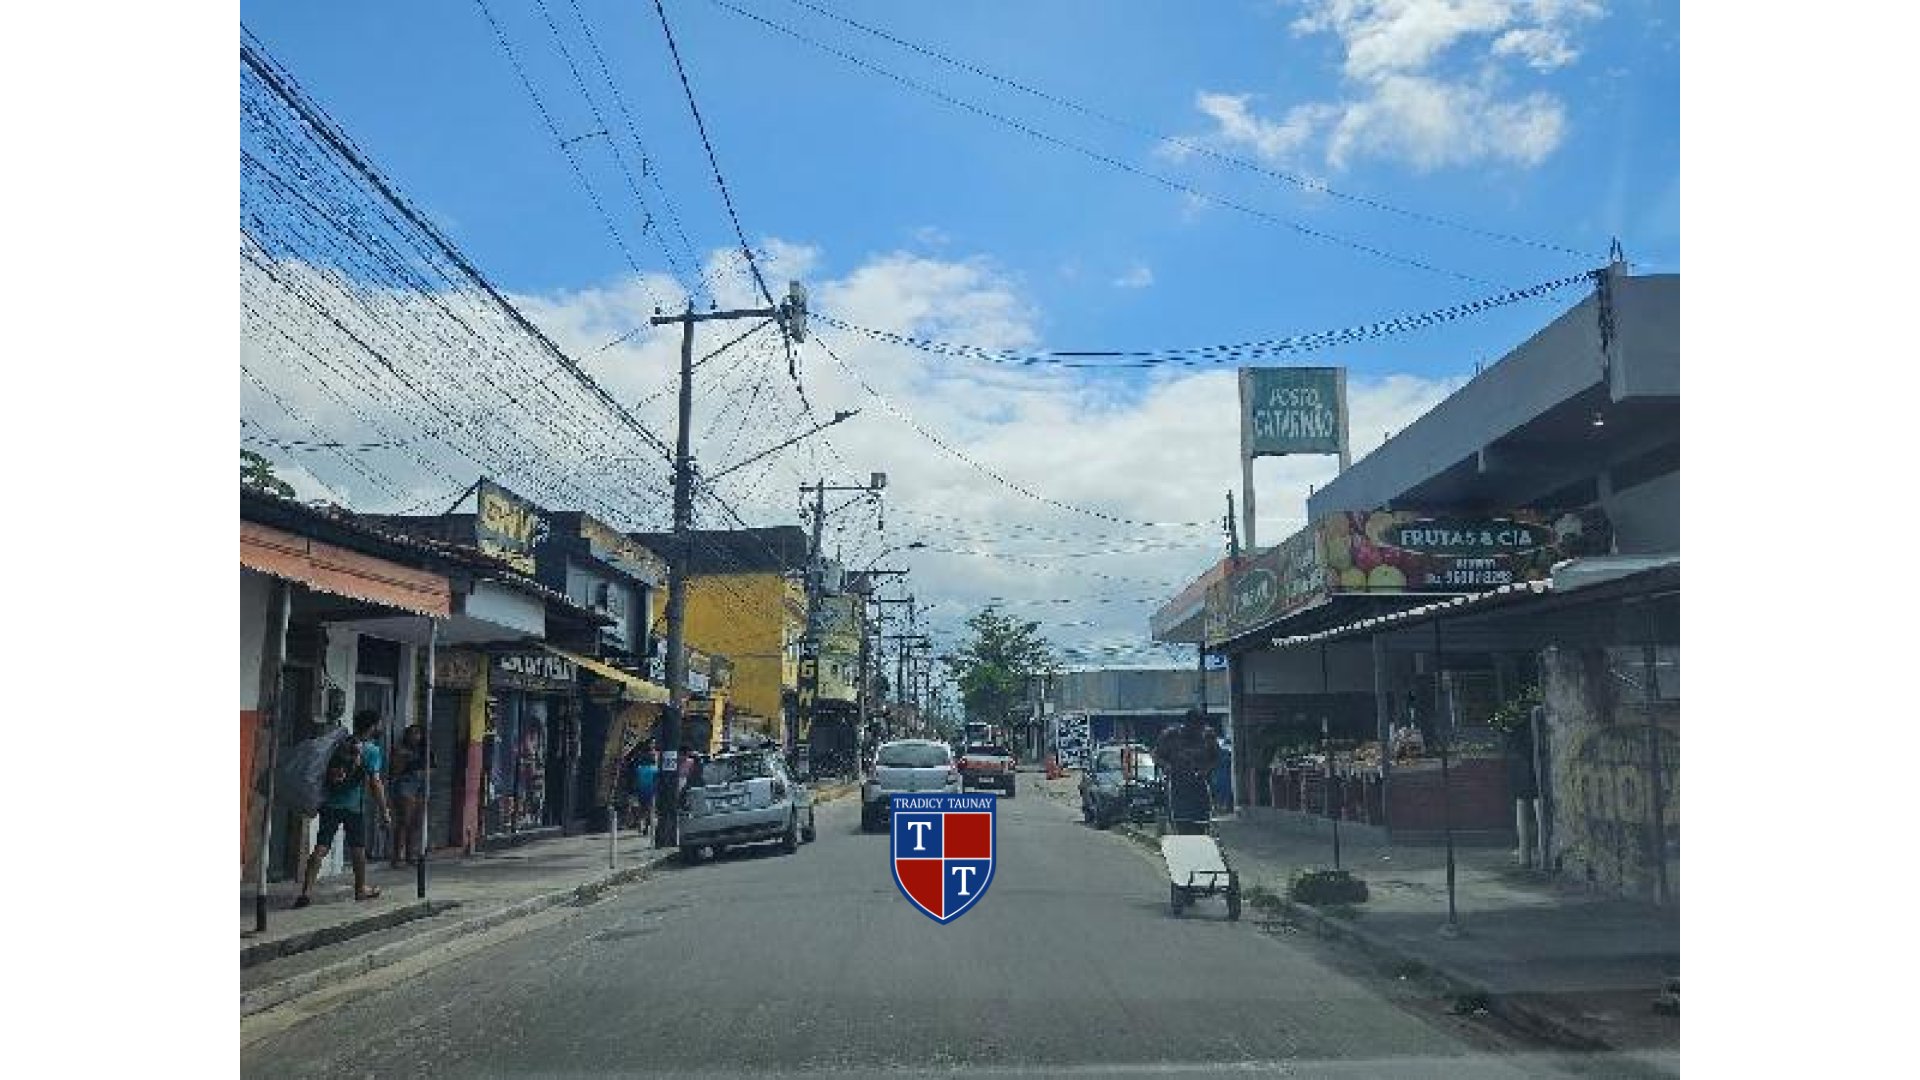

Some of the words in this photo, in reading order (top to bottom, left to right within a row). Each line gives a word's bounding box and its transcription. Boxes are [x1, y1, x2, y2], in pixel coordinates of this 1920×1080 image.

[1269, 387, 1319, 406] POSTO
[1400, 529, 1476, 546] FRUTAS
[1480, 530, 1494, 546] &
[1499, 529, 1532, 546] CIA
